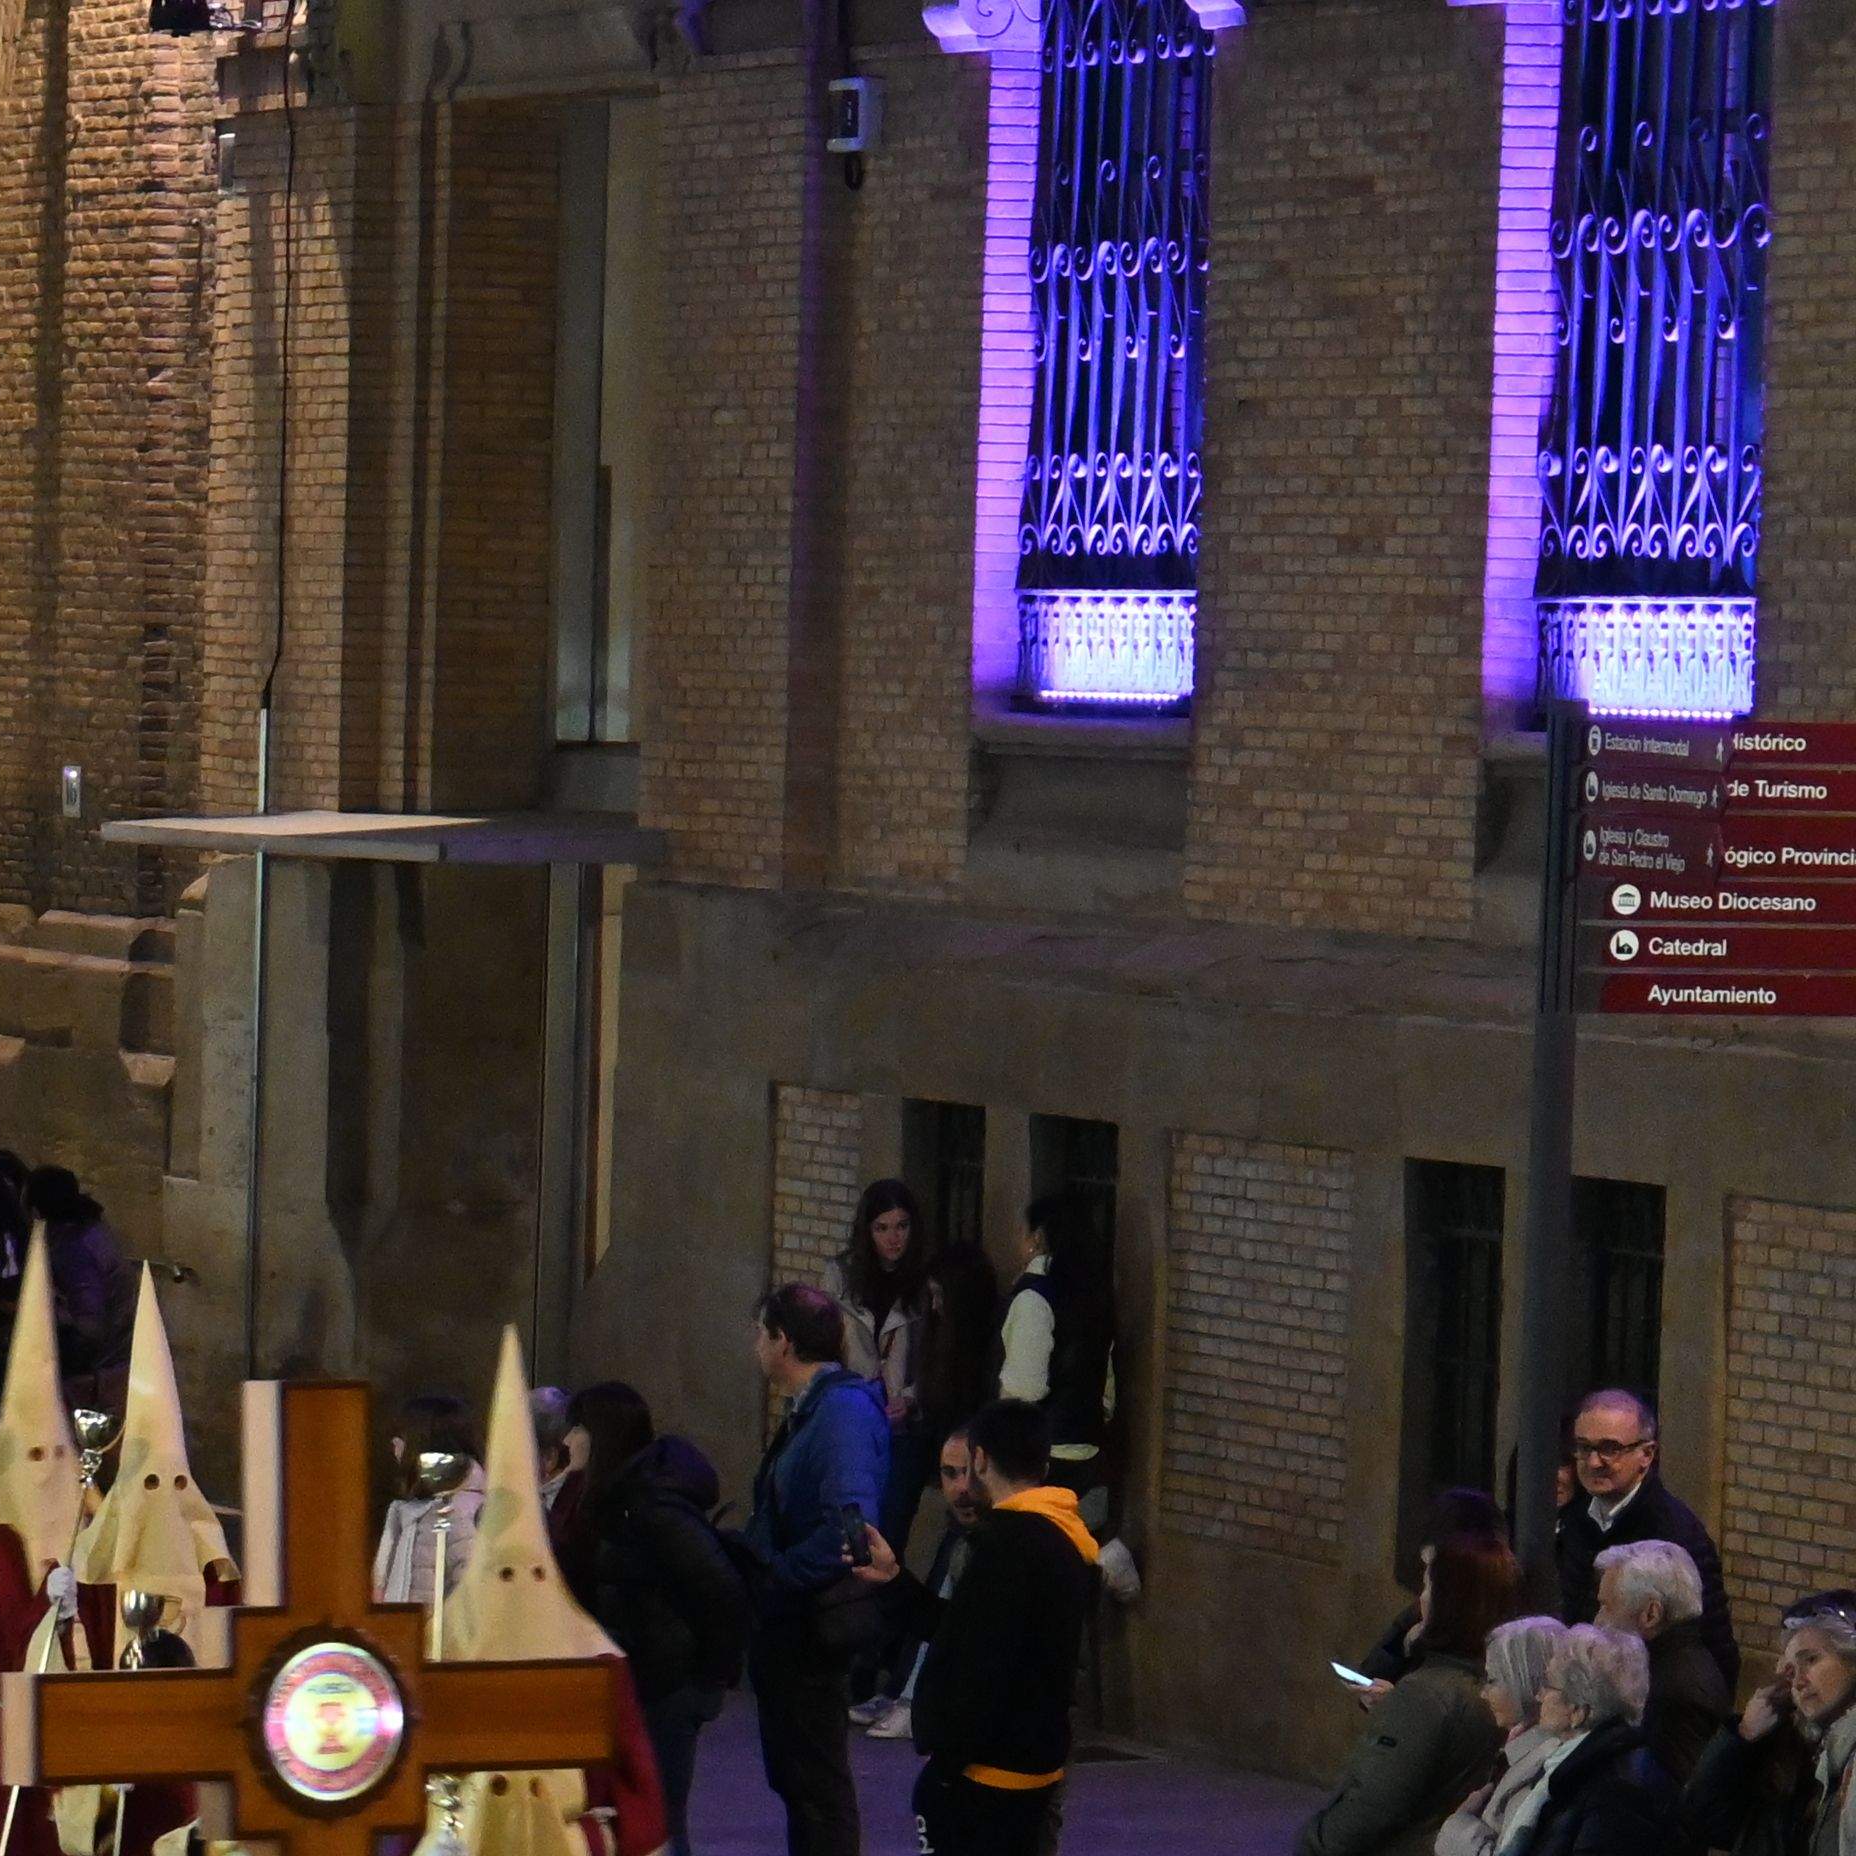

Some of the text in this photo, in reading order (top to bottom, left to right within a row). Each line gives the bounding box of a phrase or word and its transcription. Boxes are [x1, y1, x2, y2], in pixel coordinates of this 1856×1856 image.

[1754, 780, 1827, 799] Turismo
[1650, 891, 1816, 911] Museo Diocesano
[1649, 937, 1727, 956] Catedral
[1648, 984, 1777, 1006] Ayuntamiento
